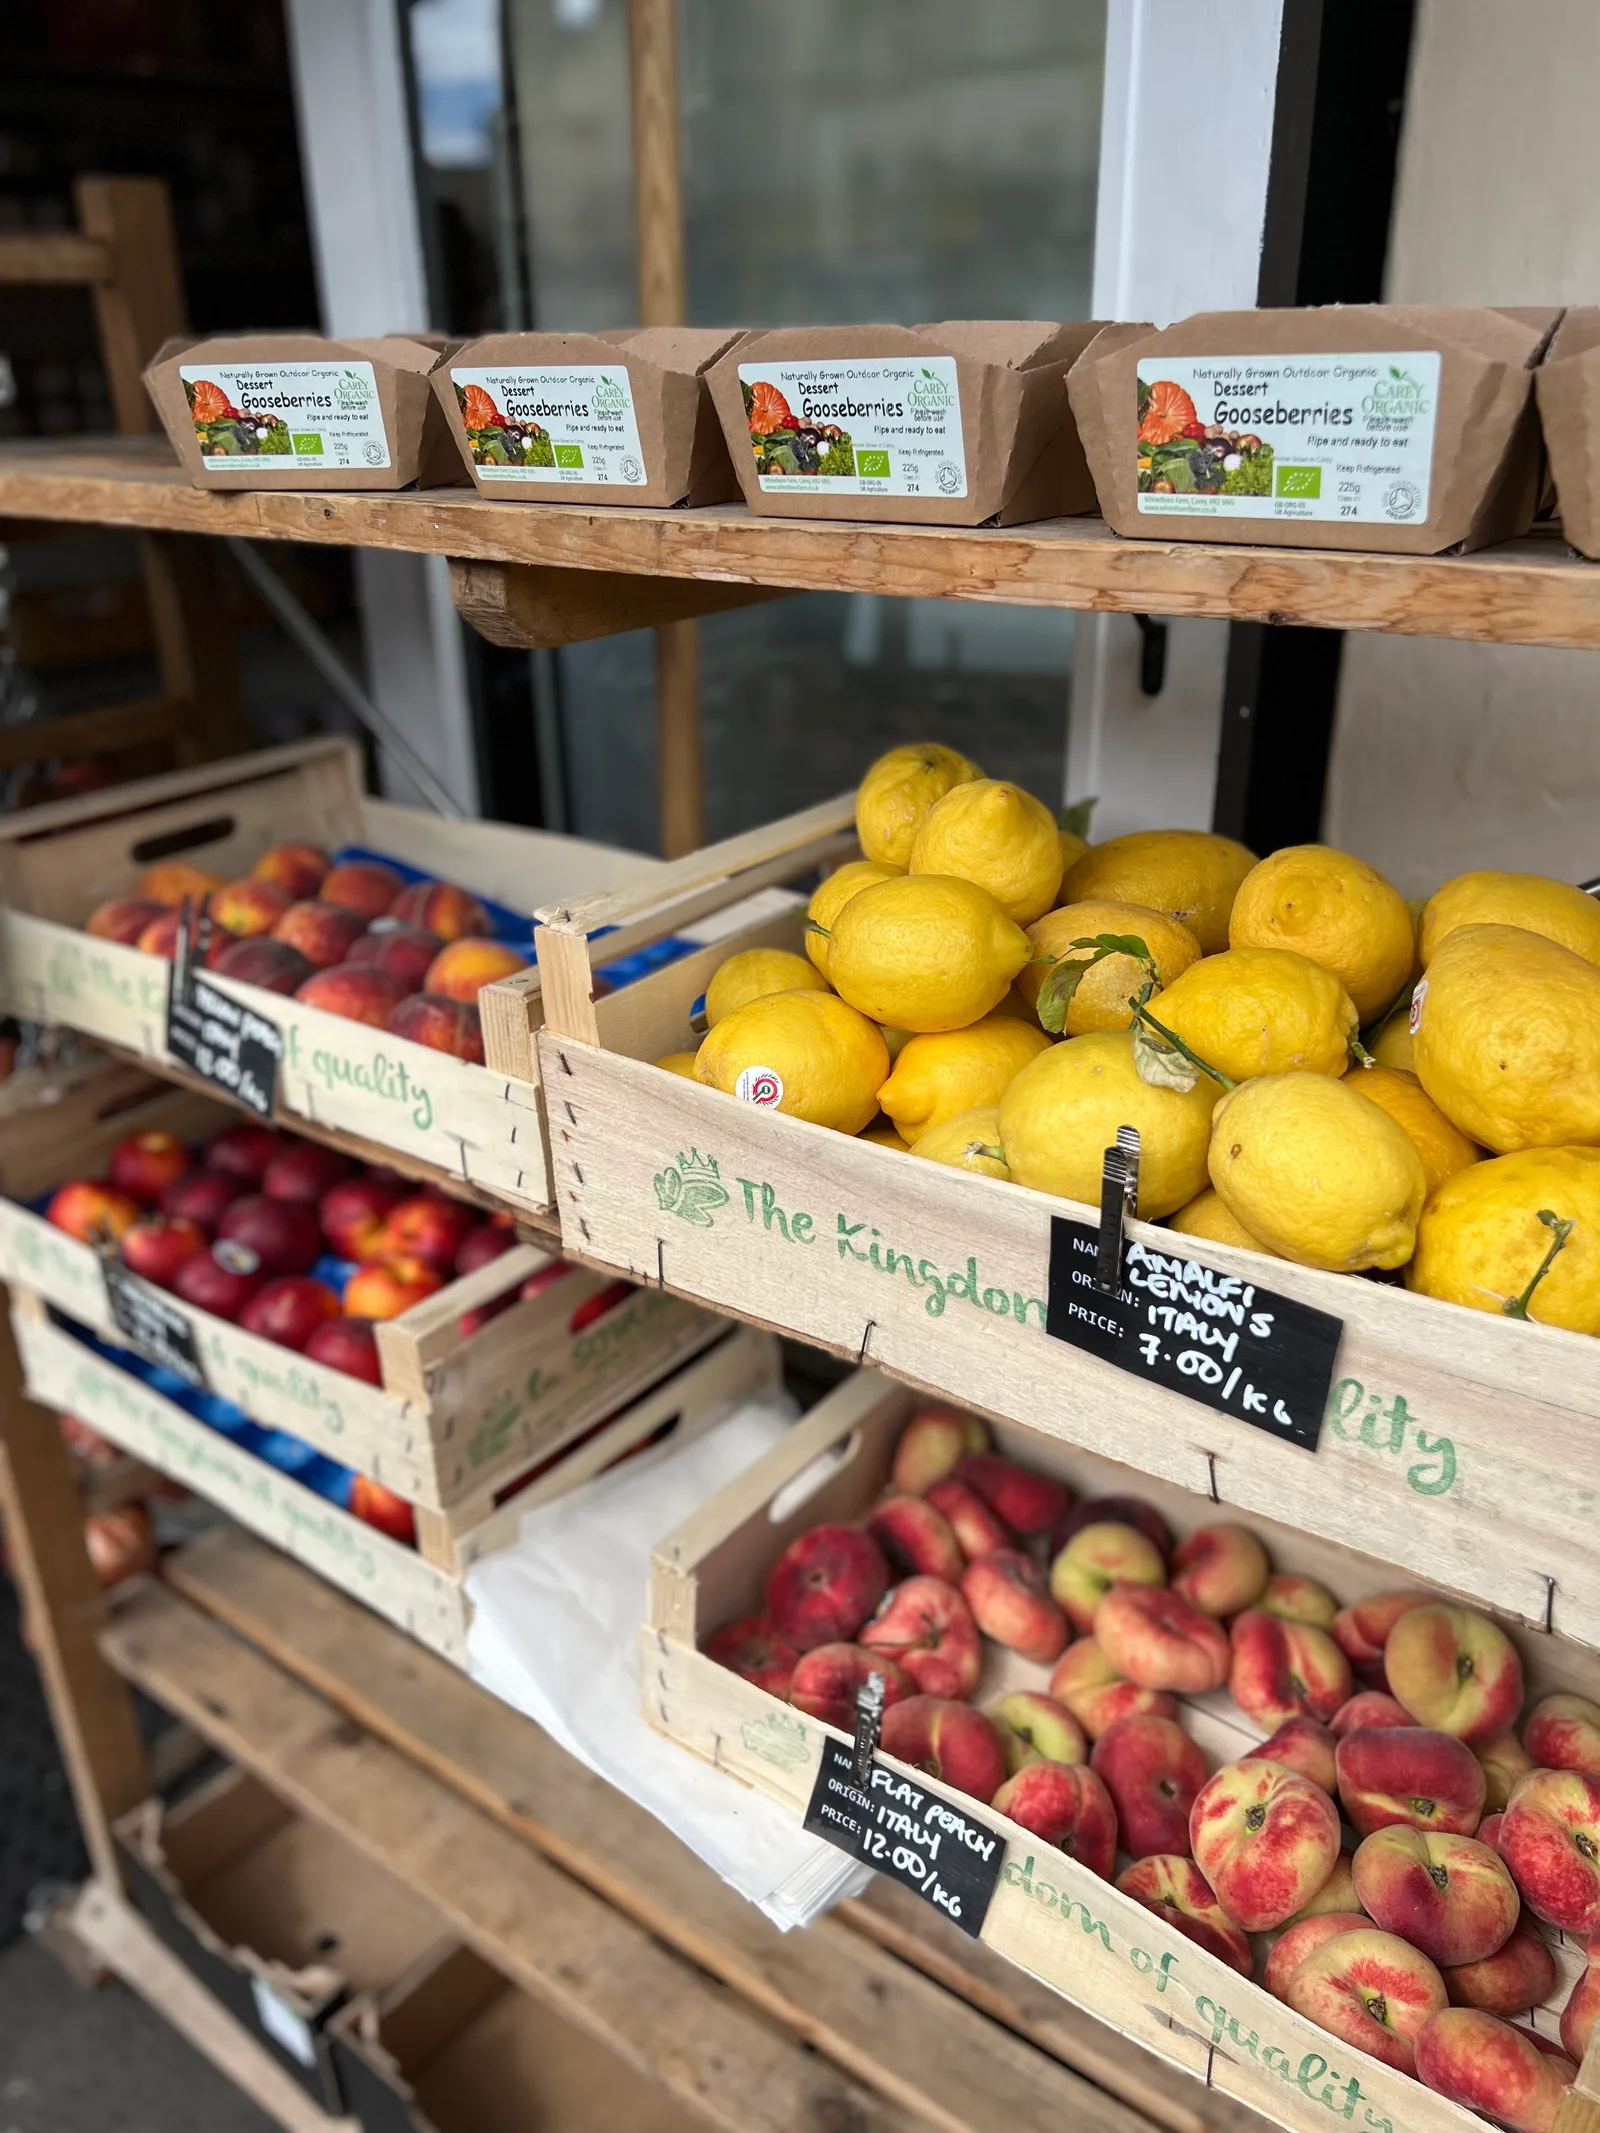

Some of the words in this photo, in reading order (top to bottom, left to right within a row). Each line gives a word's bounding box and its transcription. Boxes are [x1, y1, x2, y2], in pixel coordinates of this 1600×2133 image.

[219, 371, 254, 380] Naturally
[255, 370, 278, 378] Grown
[279, 370, 309, 378] Outdoor
[311, 369, 339, 379] Organic
[485, 376, 517, 386] Naturally
[518, 376, 539, 384] Grown
[540, 375, 568, 384] Outdoor
[569, 375, 595, 385] Organic
[780, 371, 818, 382] Naturally
[819, 370, 845, 380] Grown
[846, 369, 881, 380] Outdoor
[882, 368, 915, 381] Organic
[1192, 368, 1243, 382] Naturally
[1245, 367, 1279, 379] Grown
[1282, 366, 1330, 378] Outdoor
[1333, 366, 1379, 381] Organic
[236, 379, 274, 390] Dessert
[338, 378, 369, 391] CAREY
[501, 385, 535, 397] Dessert
[595, 385, 625, 398] CAREY
[798, 381, 839, 395] Dessert
[913, 379, 949, 394] CAREY
[1213, 380, 1269, 397] Dessert
[1373, 380, 1426, 399] CAREY
[241, 391, 332, 409] Gooseberries
[333, 388, 376, 400] ORGANIC
[907, 391, 956, 407] ORGANIC
[506, 398, 589, 417] Gooseberries
[591, 395, 631, 408] ORGANIC
[802, 396, 904, 418] Gooseberries
[1361, 396, 1430, 415] ORGANIC
[307, 414, 320, 422] Ripe
[334, 414, 351, 422] ready
[1214, 400, 1353, 426] Gooseberries
[565, 424, 579, 432] Ripe
[579, 424, 591, 432] and
[591, 424, 608, 433] ready
[608, 424, 614, 432] to
[874, 425, 890, 435] Ripe
[890, 425, 904, 434] and
[905, 426, 925, 436] ready
[926, 426, 934, 434] to
[934, 426, 946, 435] eat
[1366, 422, 1391, 432] before
[333, 443, 348, 451] 225g
[1307, 436, 1328, 448] Ripe
[1330, 436, 1349, 447] and
[1350, 436, 1379, 449] ready
[1380, 437, 1391, 447] to
[1393, 437, 1409, 447] eat
[898, 449, 911, 457] Keep
[591, 456, 606, 466] 225g
[902, 463, 919, 474] 225g
[1336, 465, 1354, 474] Keep
[597, 473, 609, 481] 274
[907, 484, 920, 493] 274
[1338, 482, 1361, 495] 225g
[1340, 506, 1358, 516] 274
[312, 1049, 433, 1131] quality
[735, 1176, 816, 1244] The
[1125, 1241, 1256, 1308] AMALFI
[1129, 1267, 1275, 1338] LEMONS
[1068, 1301, 1124, 1338] PRICE:
[1071, 1270, 1139, 1308] ORN:
[1147, 1304, 1240, 1363] ITALY
[1328, 1377, 1457, 1497] lity
[820, 1803, 862, 1835] PRICE:
[827, 1778, 875, 1813] ORIGIN:
[876, 1806, 942, 1861] ITALY
[870, 1768, 925, 1811] FLAT
[924, 1804, 997, 1862] PEACH
[1129, 1947, 1182, 1993] of
